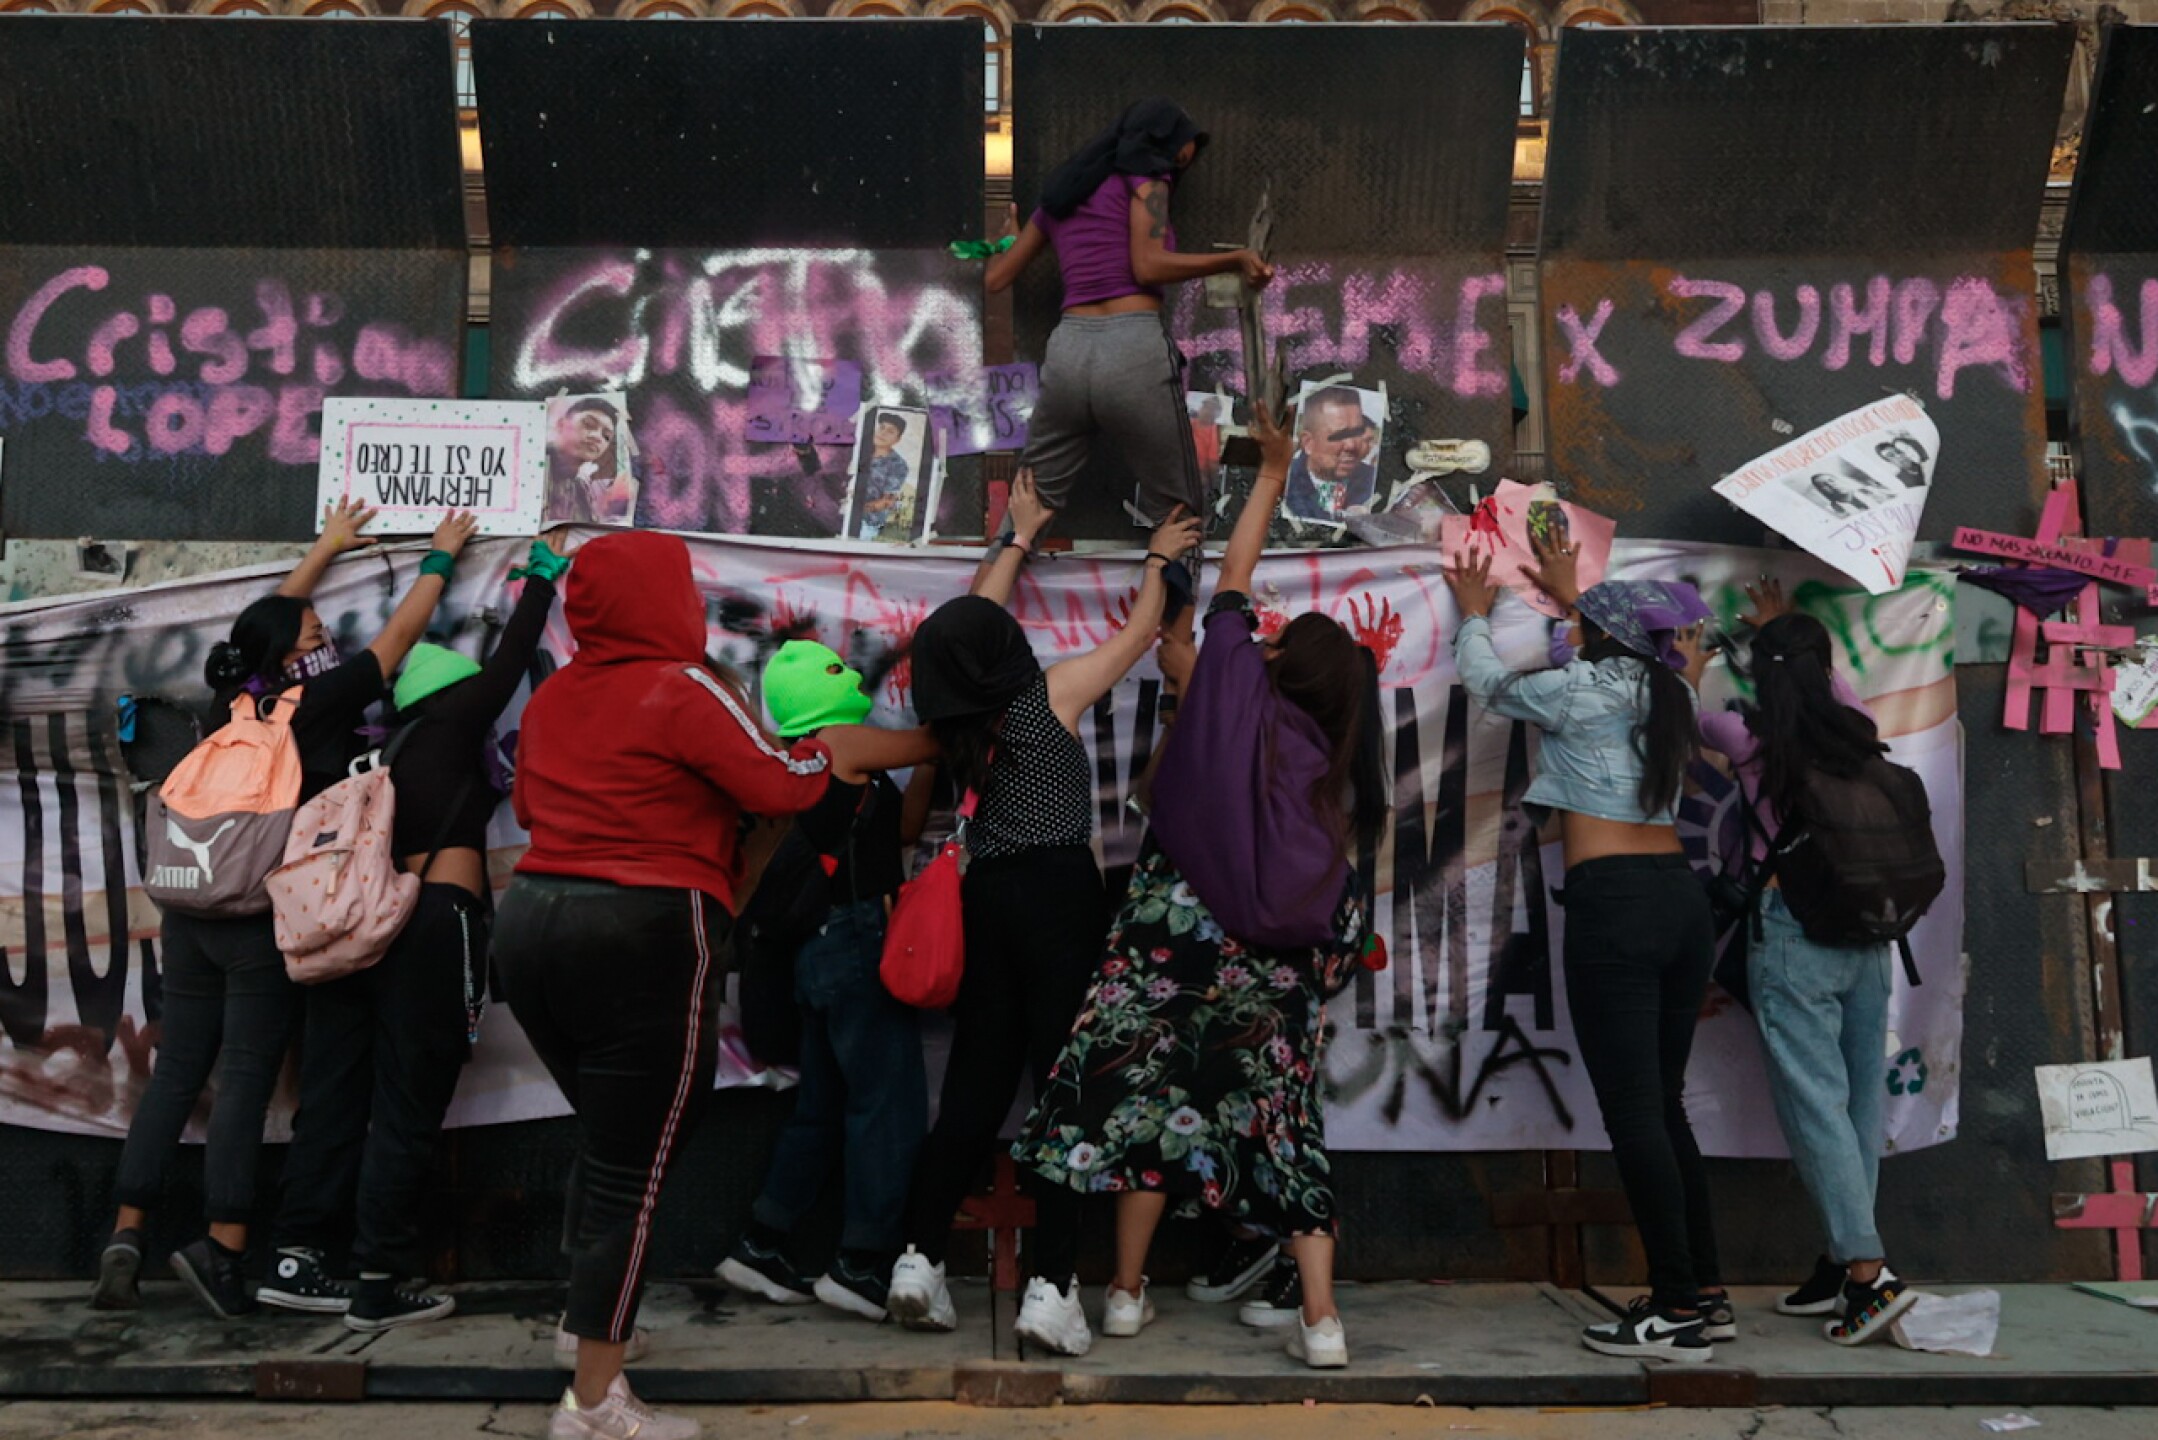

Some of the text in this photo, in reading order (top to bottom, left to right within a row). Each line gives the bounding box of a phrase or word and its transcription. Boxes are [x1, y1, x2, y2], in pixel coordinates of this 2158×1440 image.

[356, 442, 507, 477] YO SI TE CREO
[375, 475, 493, 507] HERMANA
